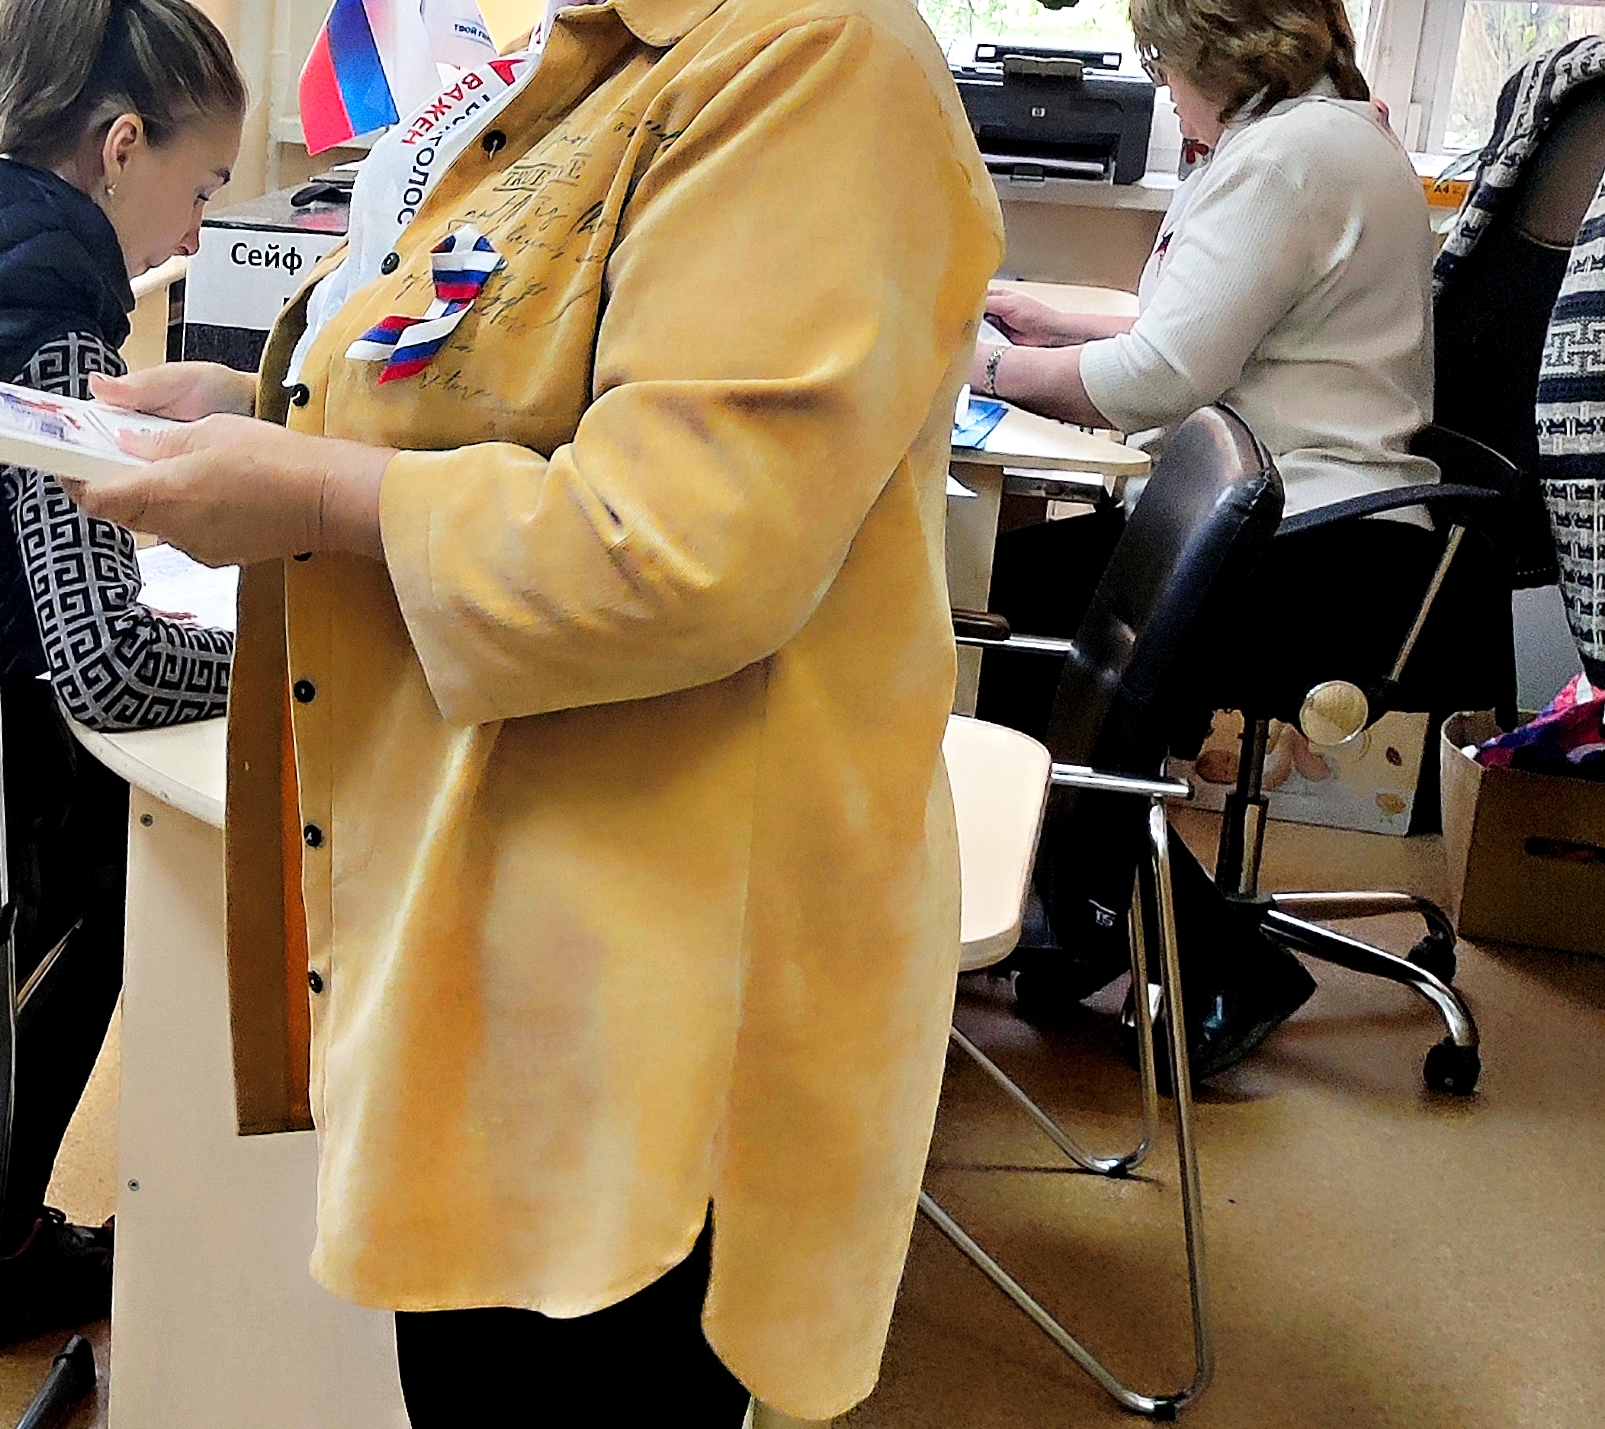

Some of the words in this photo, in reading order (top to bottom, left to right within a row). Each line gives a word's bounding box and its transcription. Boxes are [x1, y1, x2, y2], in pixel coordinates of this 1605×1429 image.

[454, 23, 477, 36] ТВОЙ
[400, 72, 484, 146] ВАЖЕН
[230, 242, 303, 276] Сейф
